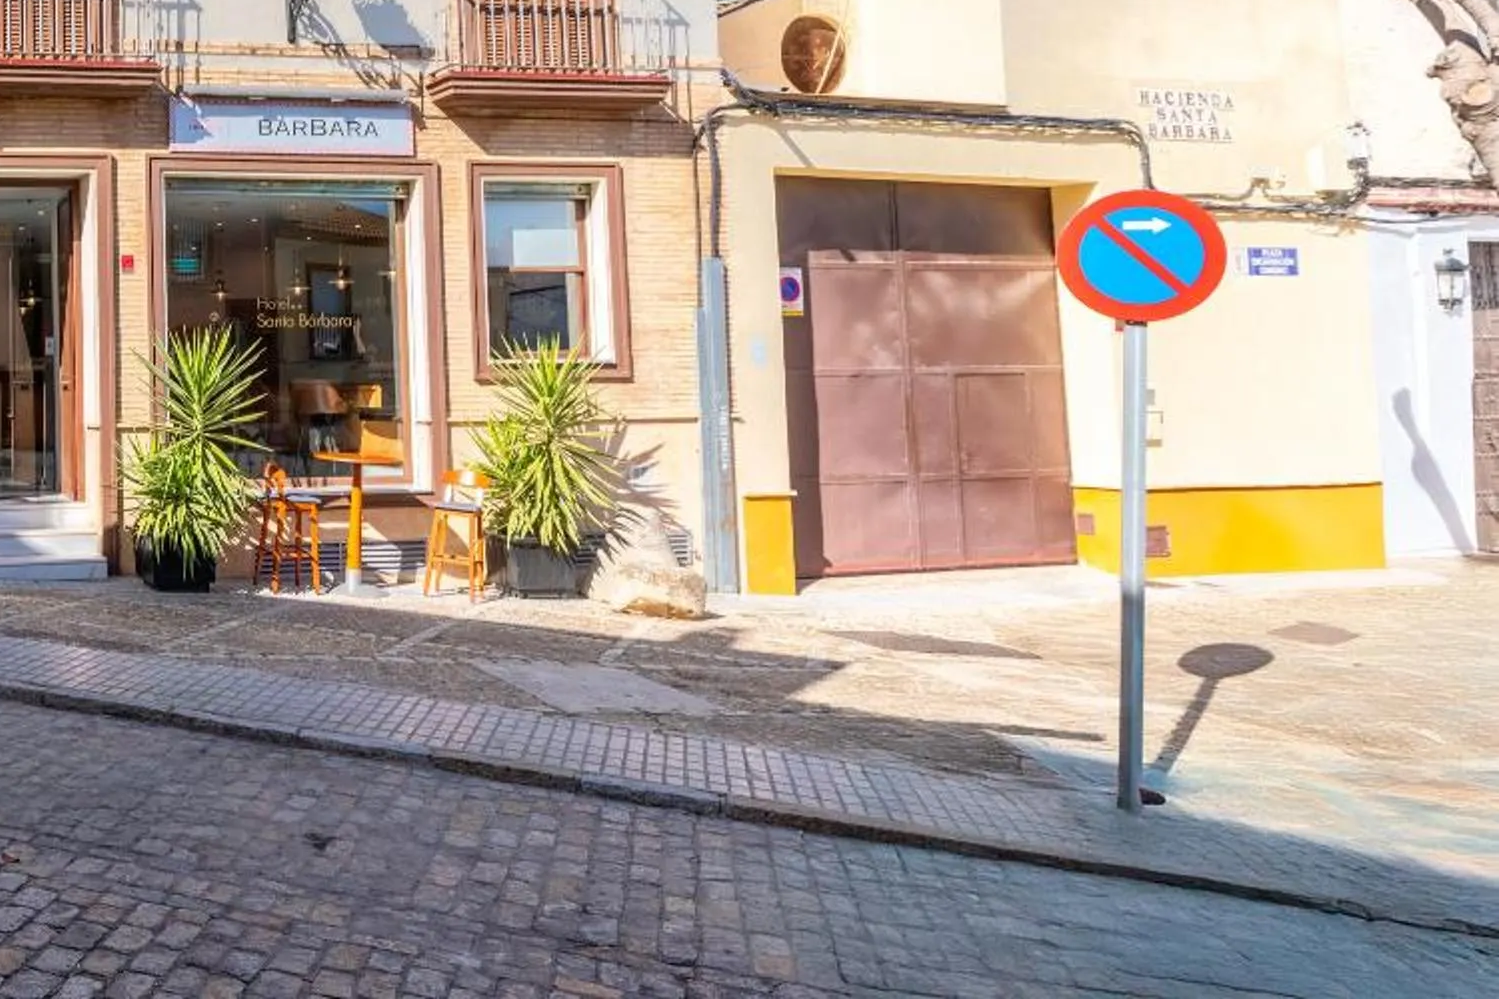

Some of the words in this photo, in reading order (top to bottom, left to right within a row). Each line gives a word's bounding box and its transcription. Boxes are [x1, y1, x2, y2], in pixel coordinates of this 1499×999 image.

[1140, 90, 1234, 109] HACIENDA
[1156, 107, 1217, 124] SANTA
[1148, 122, 1232, 141] BARBARA
[256, 297, 291, 311] Hotel
[256, 313, 295, 329] Santa
